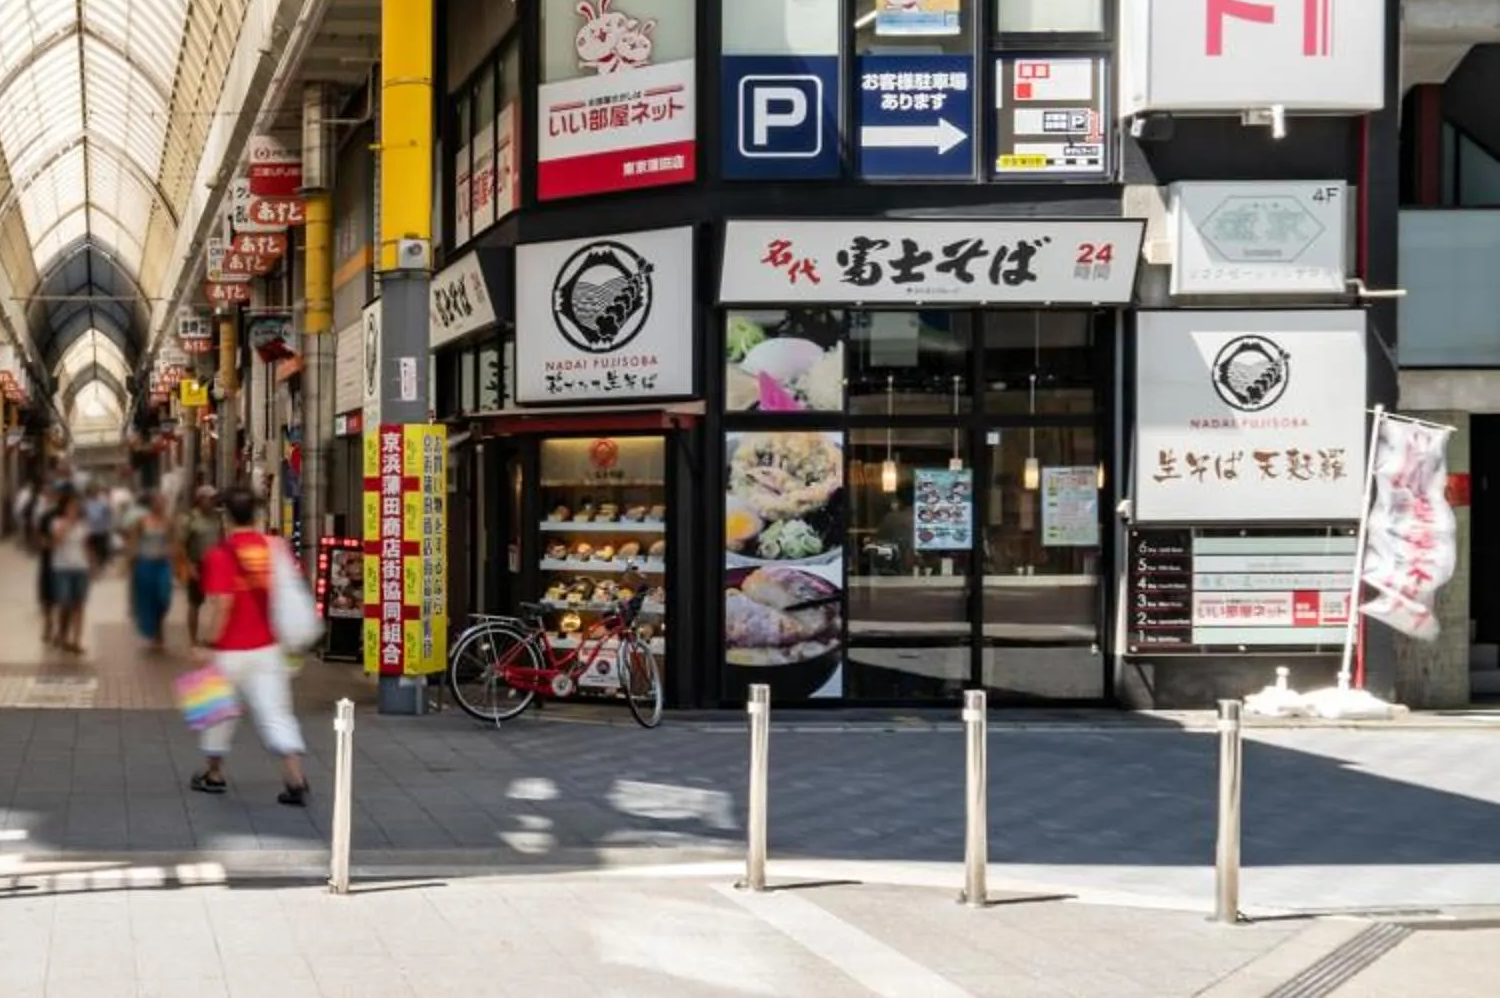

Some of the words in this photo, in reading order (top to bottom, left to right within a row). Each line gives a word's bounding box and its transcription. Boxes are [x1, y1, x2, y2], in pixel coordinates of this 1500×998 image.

[861, 71, 968, 91] お客様駐車場
[880, 93, 947, 111] あります
[548, 96, 685, 138] いい部屋ネット
[753, 87, 807, 146] P
[1312, 187, 1340, 202] 4F
[257, 201, 303, 222] あすと
[240, 236, 281, 254] あすと
[760, 239, 821, 284] 名代
[1076, 243, 1113, 264] 24
[545, 360, 588, 372] NADAI
[592, 354, 659, 370] FUJISOBA
